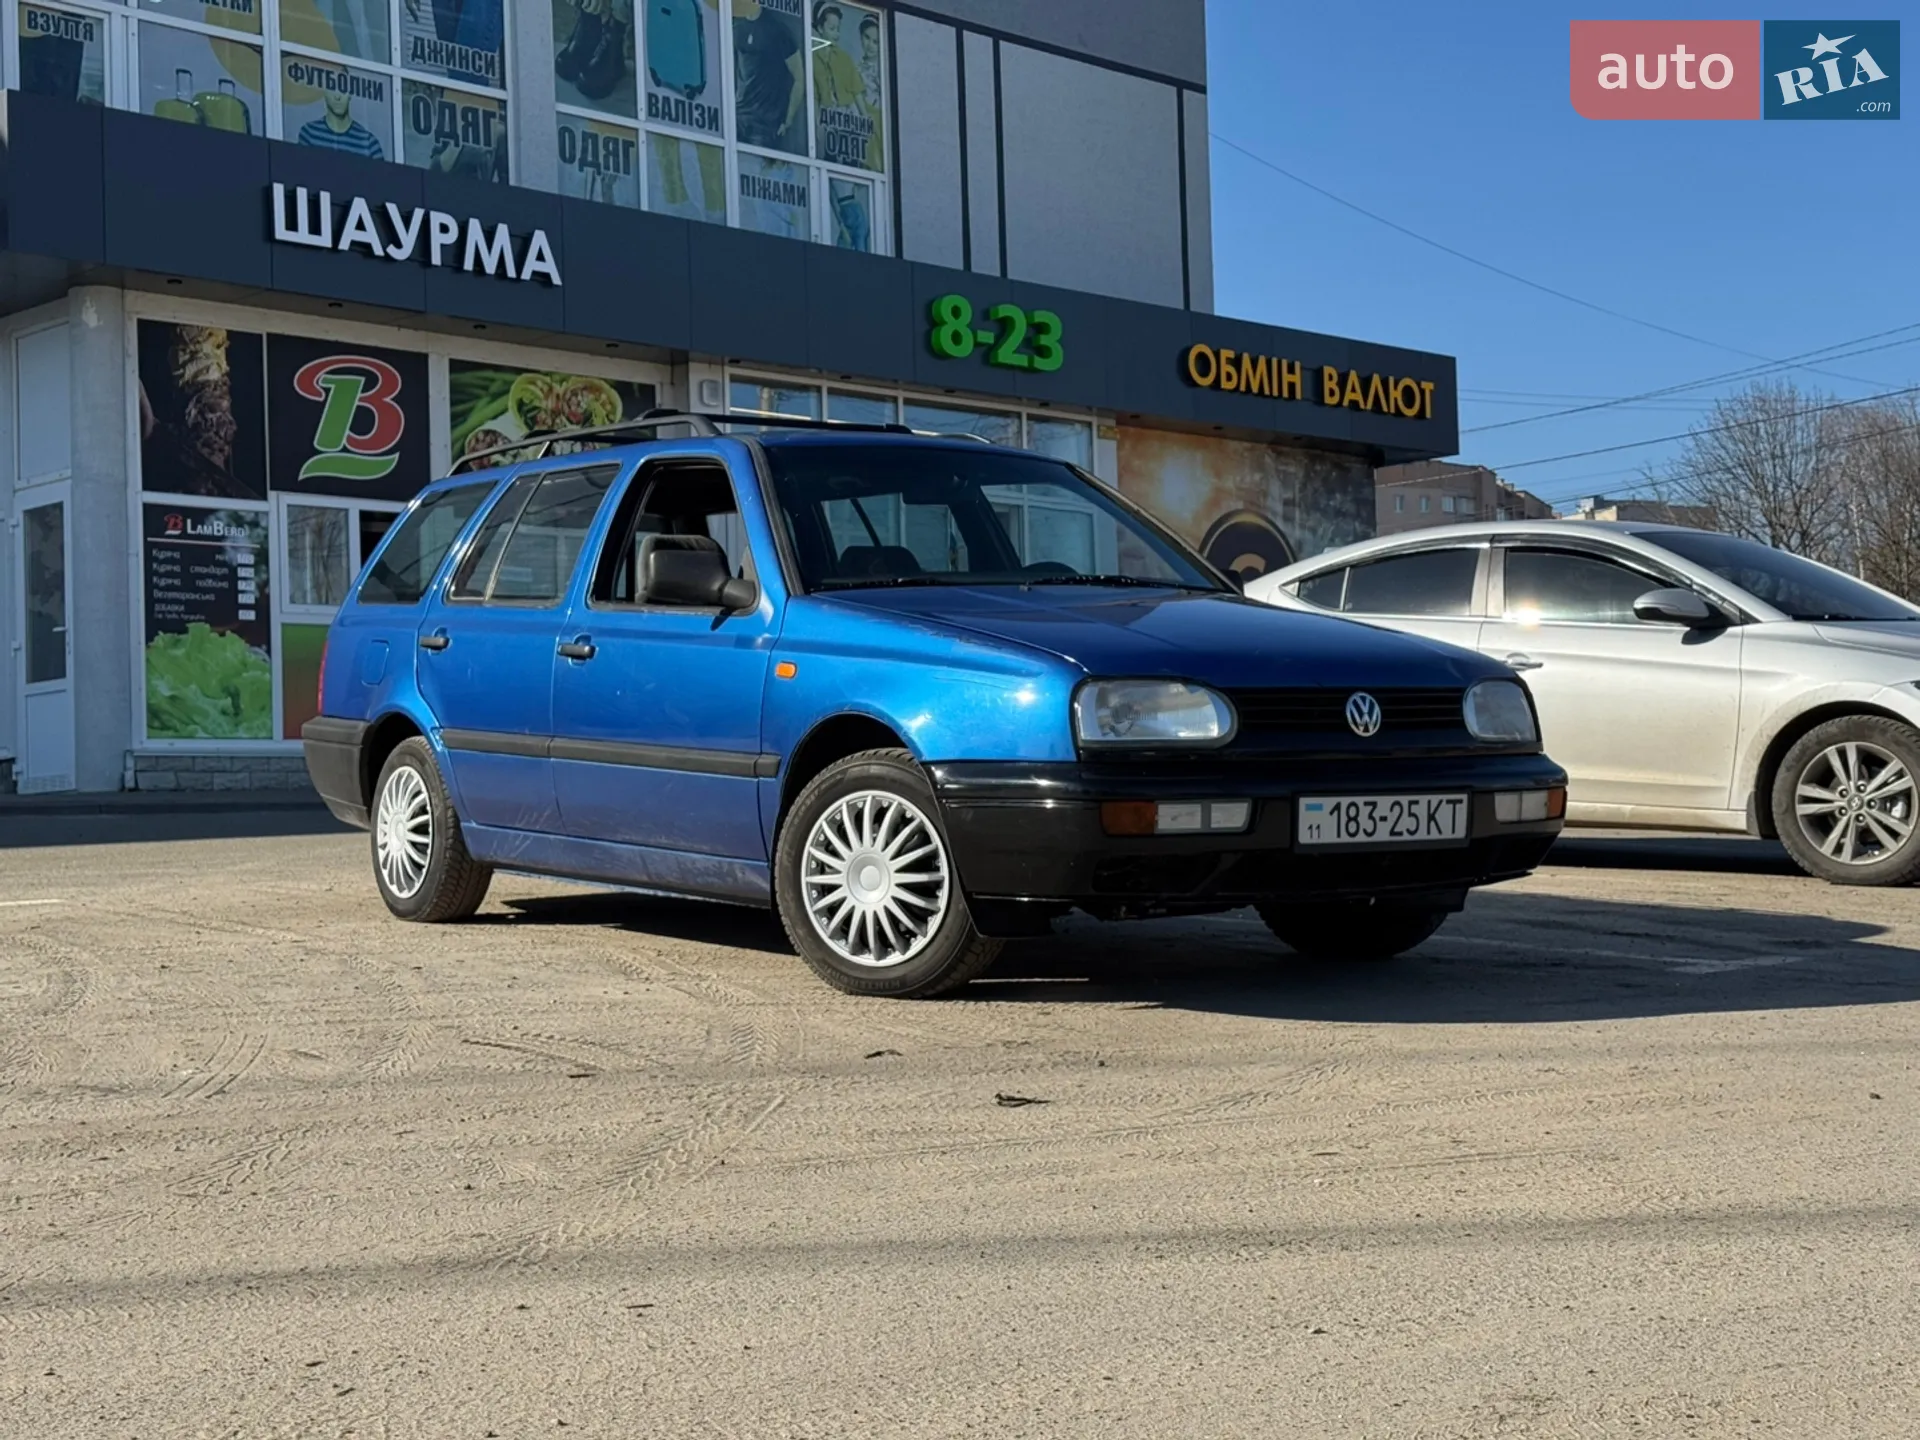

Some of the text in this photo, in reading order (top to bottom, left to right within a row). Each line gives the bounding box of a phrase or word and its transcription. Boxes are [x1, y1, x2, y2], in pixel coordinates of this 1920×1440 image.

[27, 9, 95, 42] ВЗУТТЯ
[410, 35, 498, 78] ДЖИНСИ
[287, 62, 385, 103] ФУТБОЛКИ
[412, 94, 499, 148] ОДЯГ
[646, 92, 719, 133] ВАЛІЗИ
[557, 124, 636, 177] ОДЯГ
[826, 129, 869, 161] ОДЯГ
[740, 174, 808, 208] ПІЖАМИ
[273, 182, 563, 286] ШАУРМА
[931, 294, 1064, 371] 8-23
[1187, 343, 1435, 419] ОБМІН ВАЛЮТ
[1306, 823, 1322, 840] 11
